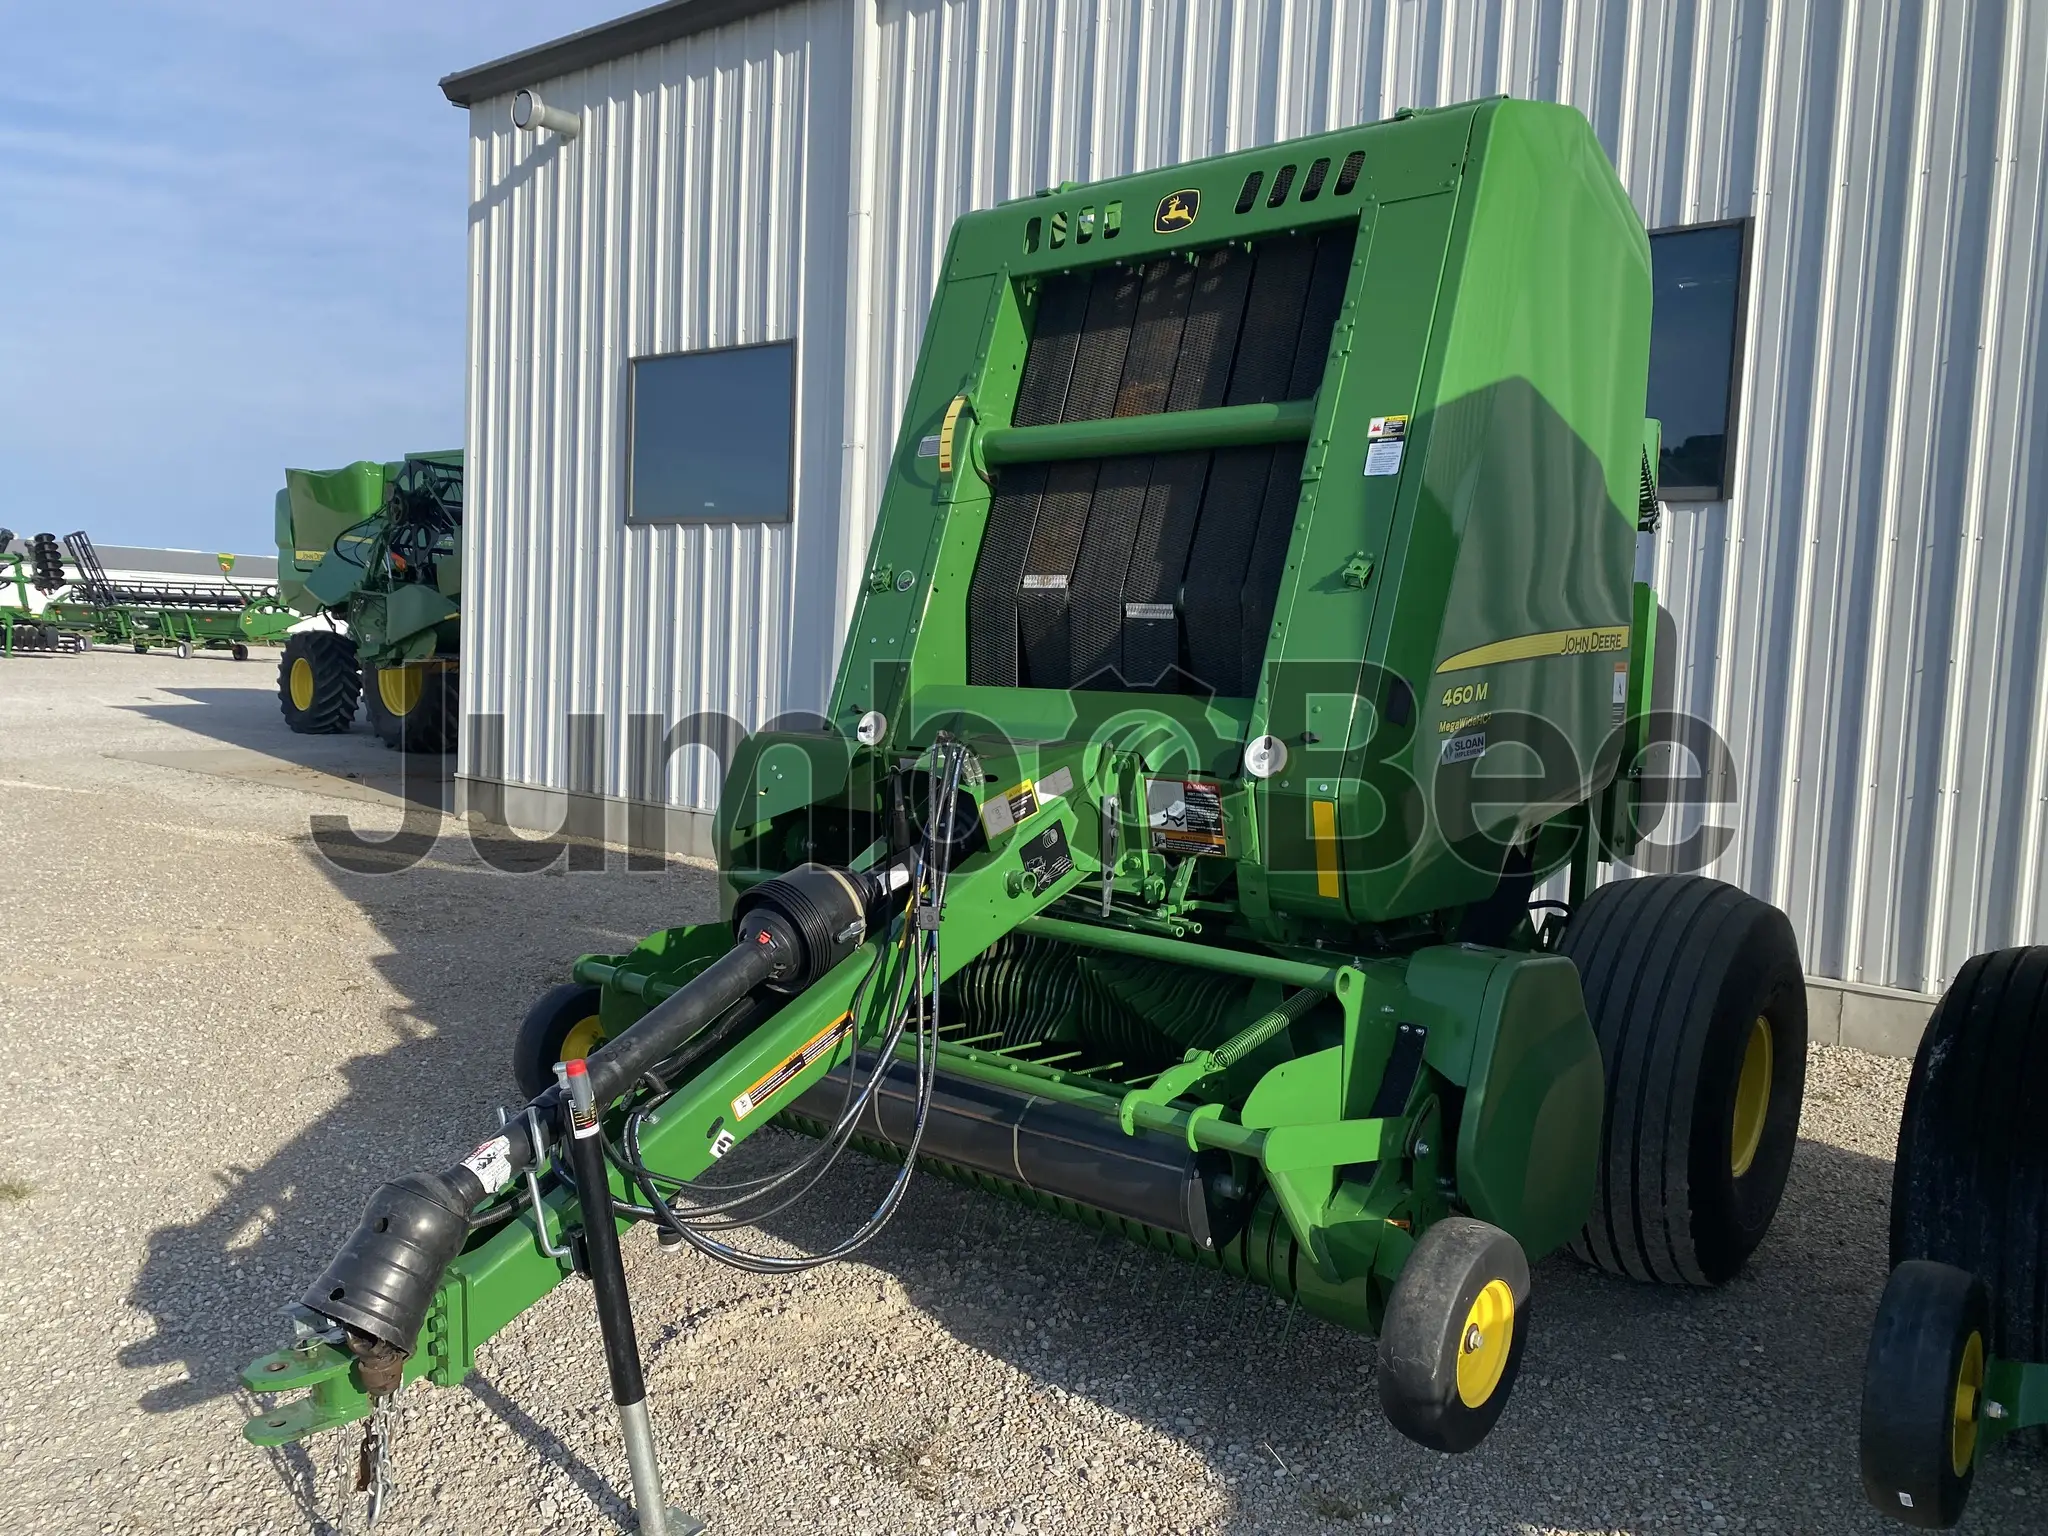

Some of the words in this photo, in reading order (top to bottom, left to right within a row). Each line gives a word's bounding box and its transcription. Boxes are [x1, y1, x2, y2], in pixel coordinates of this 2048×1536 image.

[1560, 634, 1590, 654] JOHN
[1590, 632, 1622, 650] DEERE
[1442, 685, 1474, 707] 460
[1475, 683, 1489, 702] M
[1454, 736, 1484, 752] SLOAN
[1454, 747, 1485, 759] IMPLEMENT
